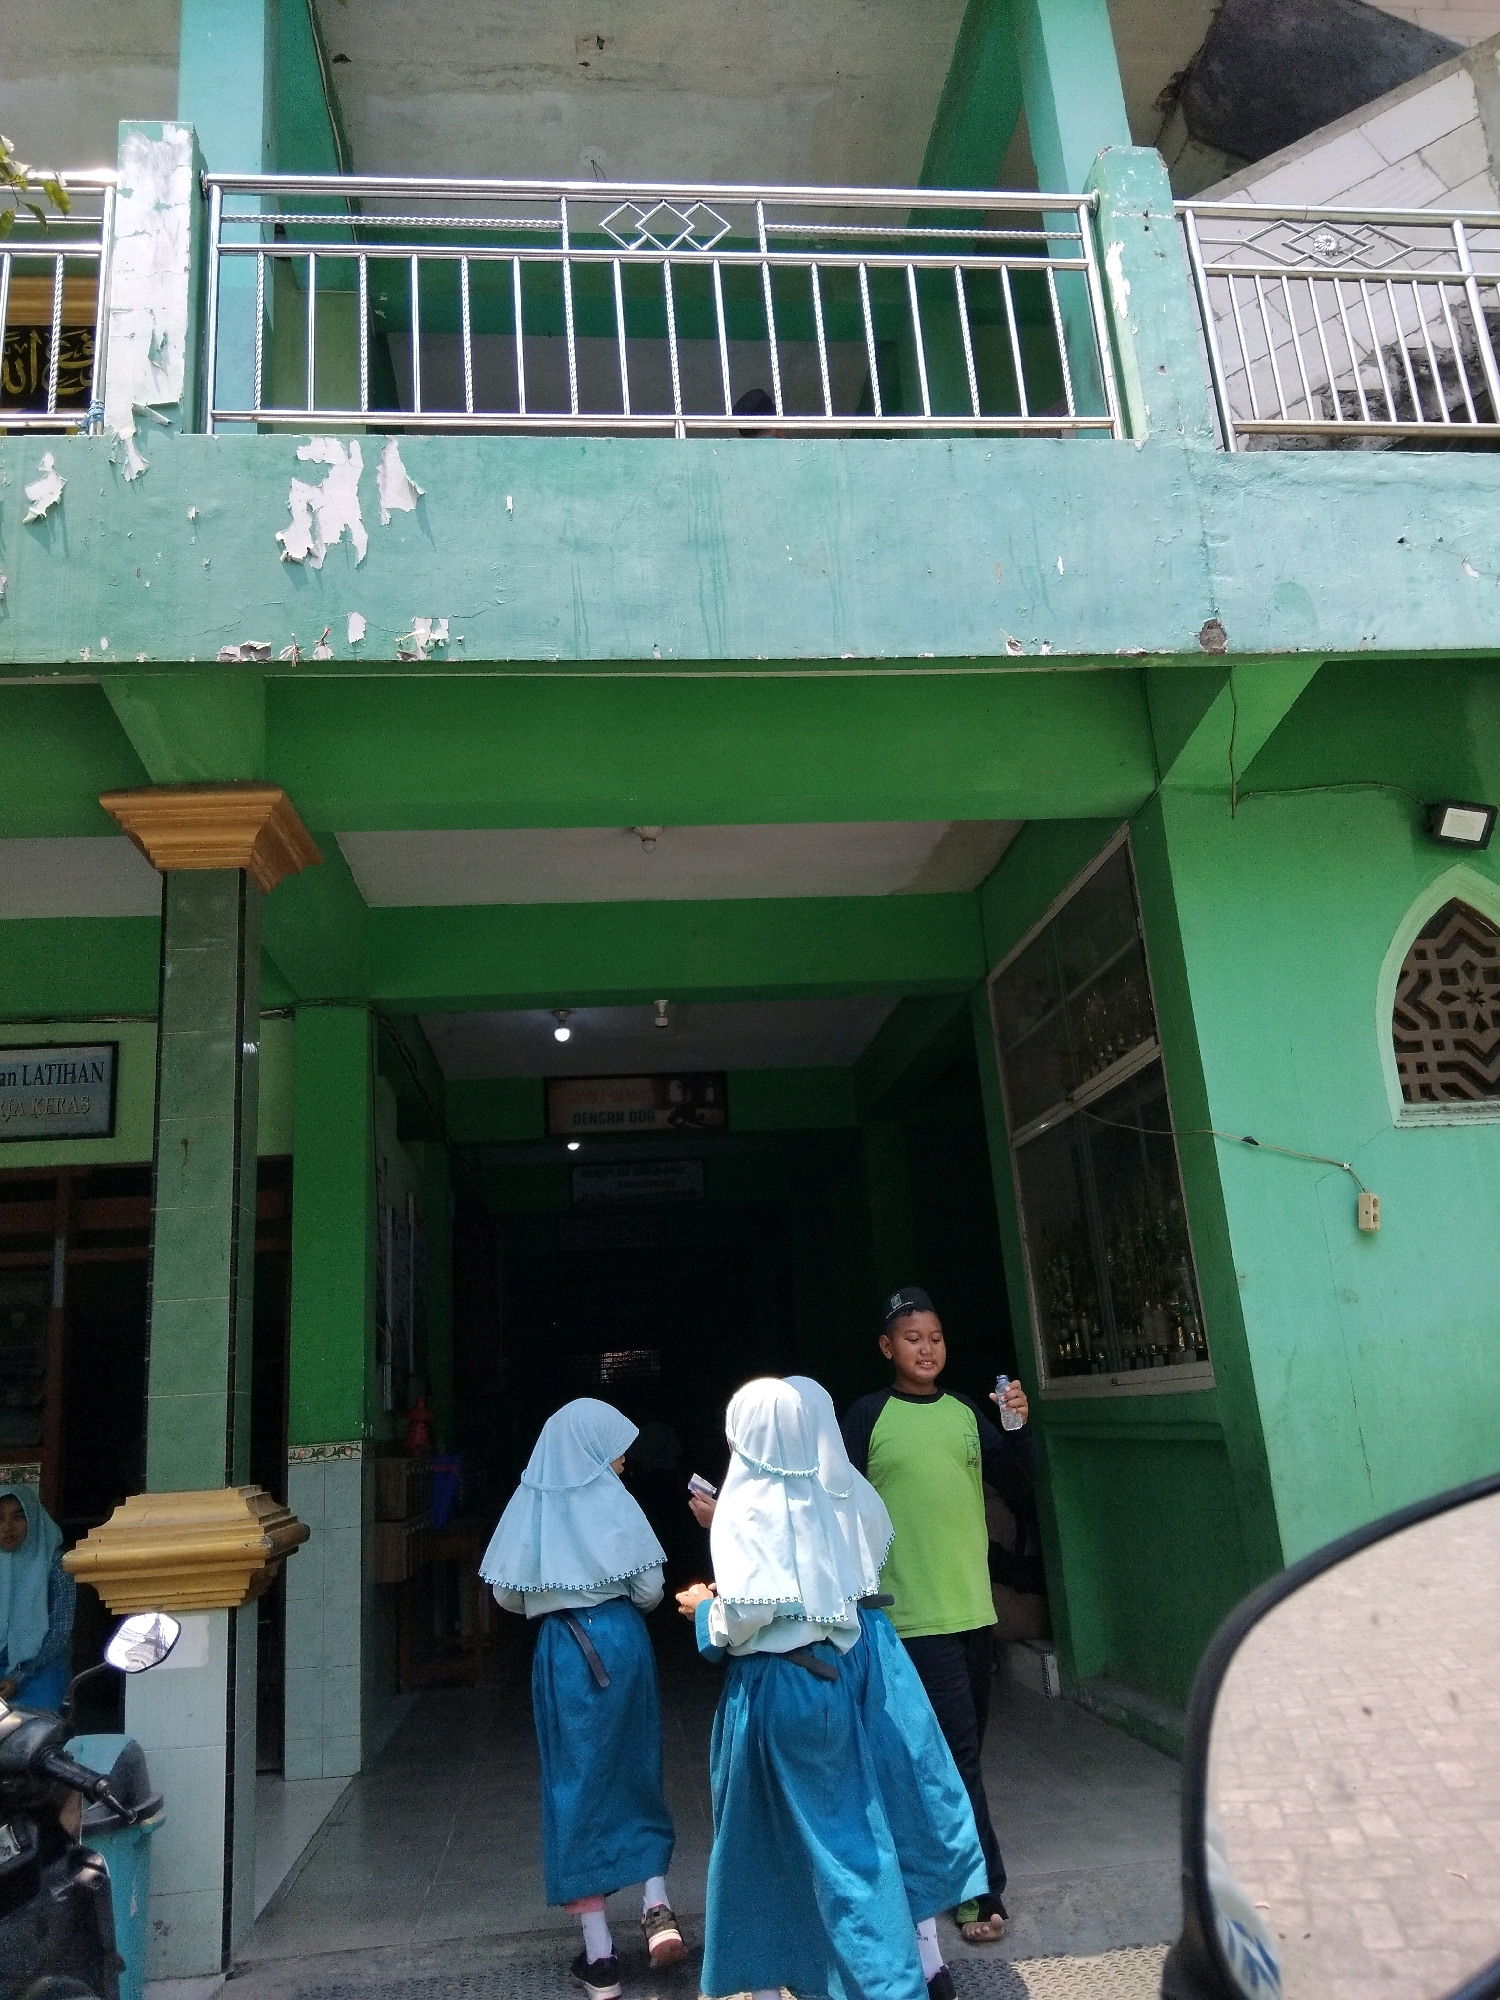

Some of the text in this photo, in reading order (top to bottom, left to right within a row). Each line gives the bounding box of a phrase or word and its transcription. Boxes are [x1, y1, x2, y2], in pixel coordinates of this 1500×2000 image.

[0, 1061, 105, 1087] an LATIHAN
[30, 1095, 91, 1117] KERAS
[573, 1111, 625, 1126] DENGAN
